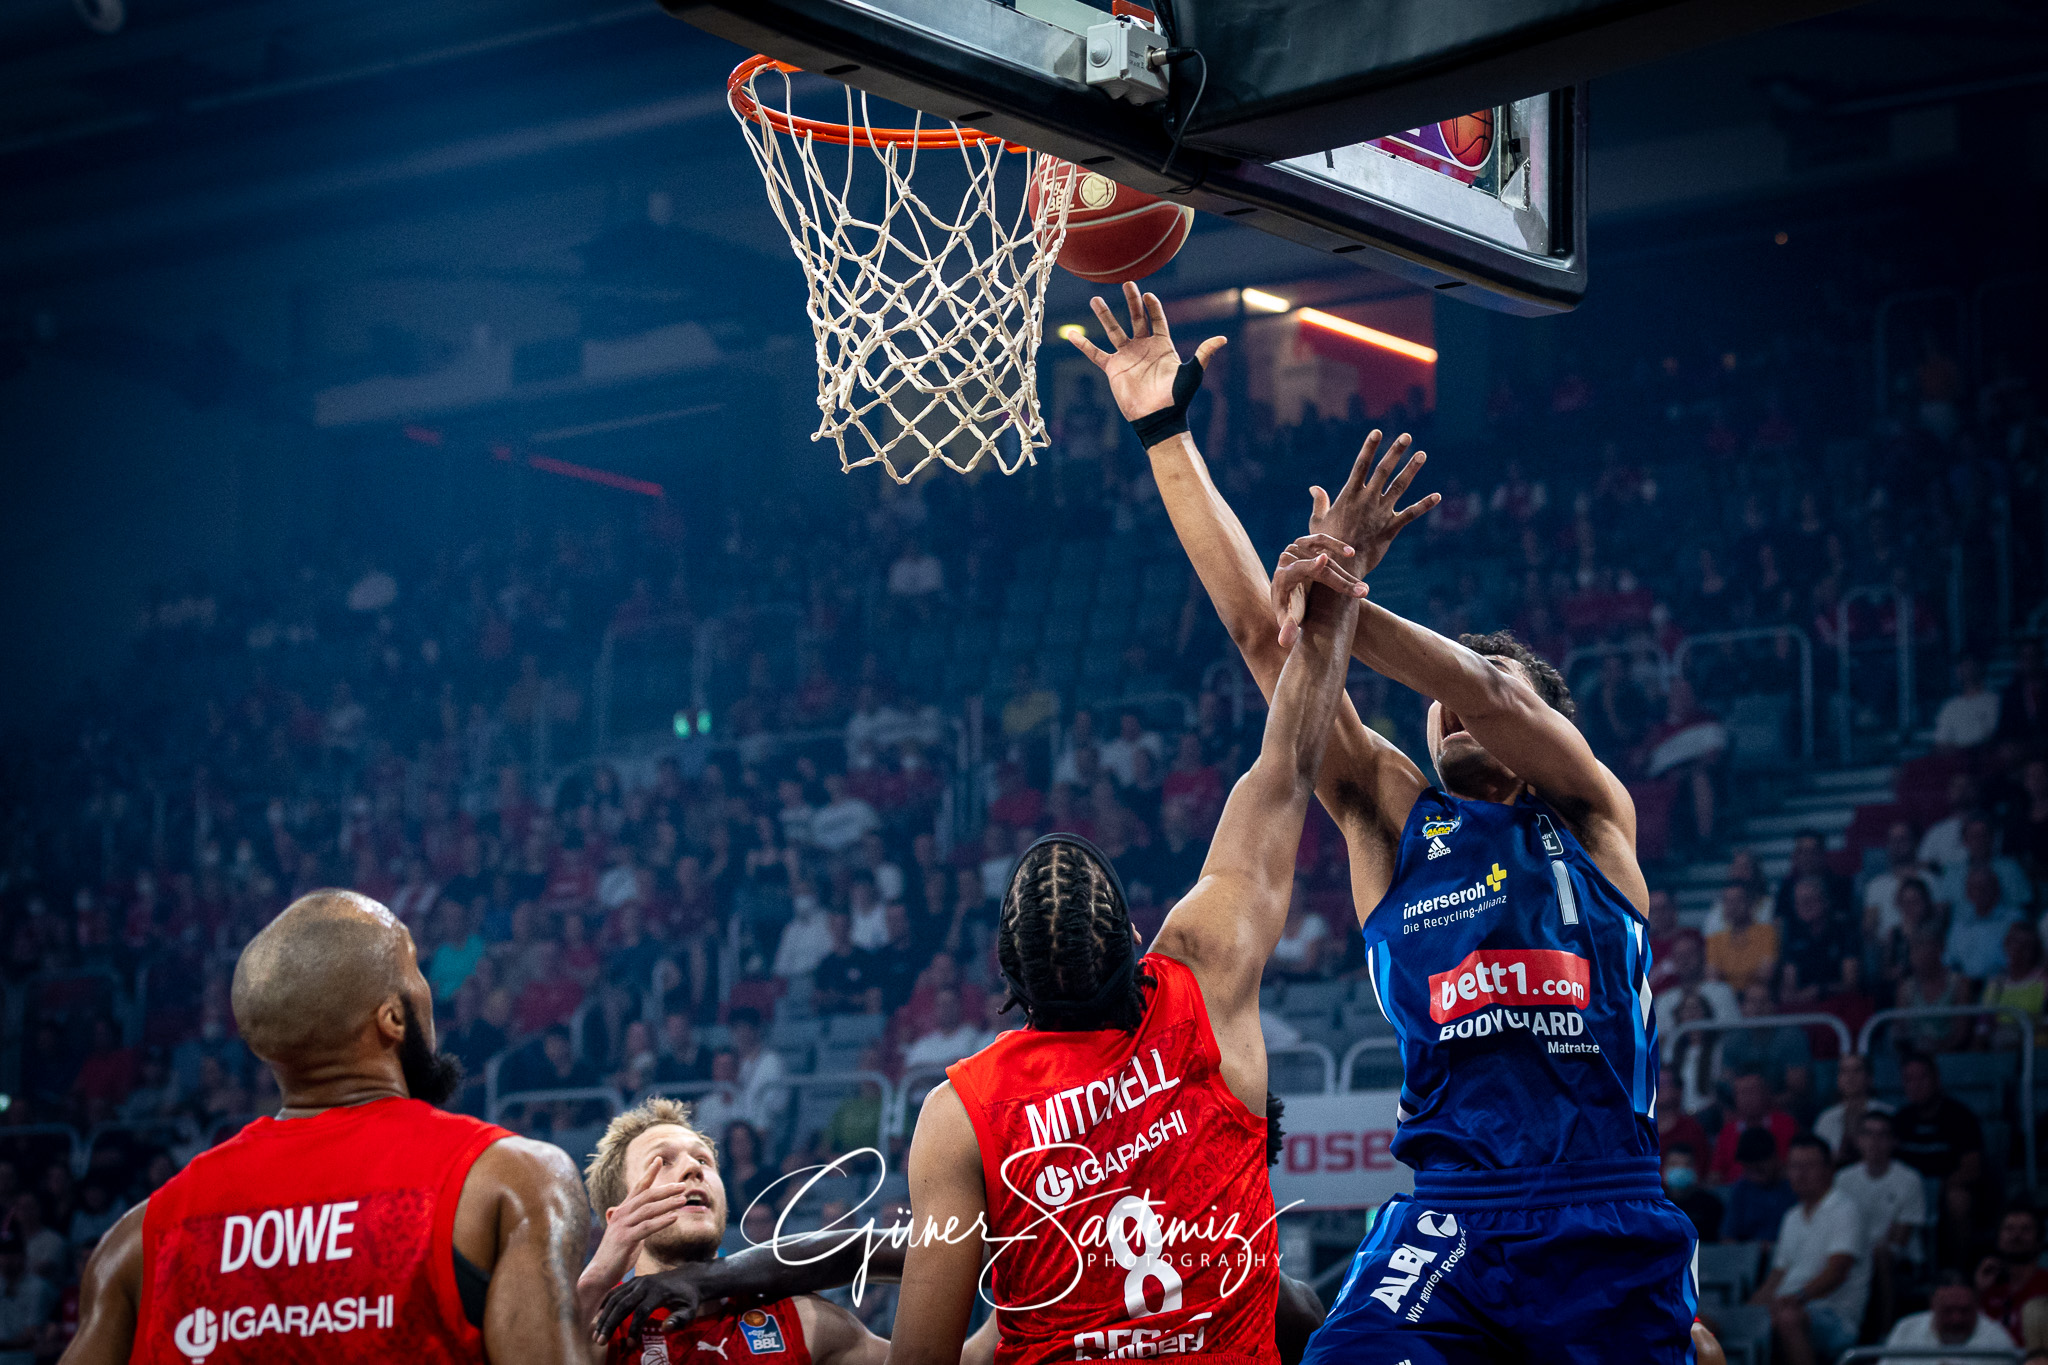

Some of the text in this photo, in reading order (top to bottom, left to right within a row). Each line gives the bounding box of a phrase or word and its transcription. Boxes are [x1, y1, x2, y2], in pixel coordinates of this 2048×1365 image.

[1427, 847, 1452, 861] adidas
[1403, 882, 1486, 920] interseroh
[1403, 895, 1507, 935] Die Recycling-Allianz
[1441, 961, 1584, 1012] bett1.com
[1547, 1041, 1600, 1054] Matratze
[1025, 1048, 1180, 1152] MITCHELL
[220, 1200, 359, 1274] DOWE
[1106, 1194, 1183, 1319] 8
[221, 1294, 394, 1342] IGARASHI
[1405, 1302, 1425, 1323] Wir
[753, 1337, 781, 1350] BBL
